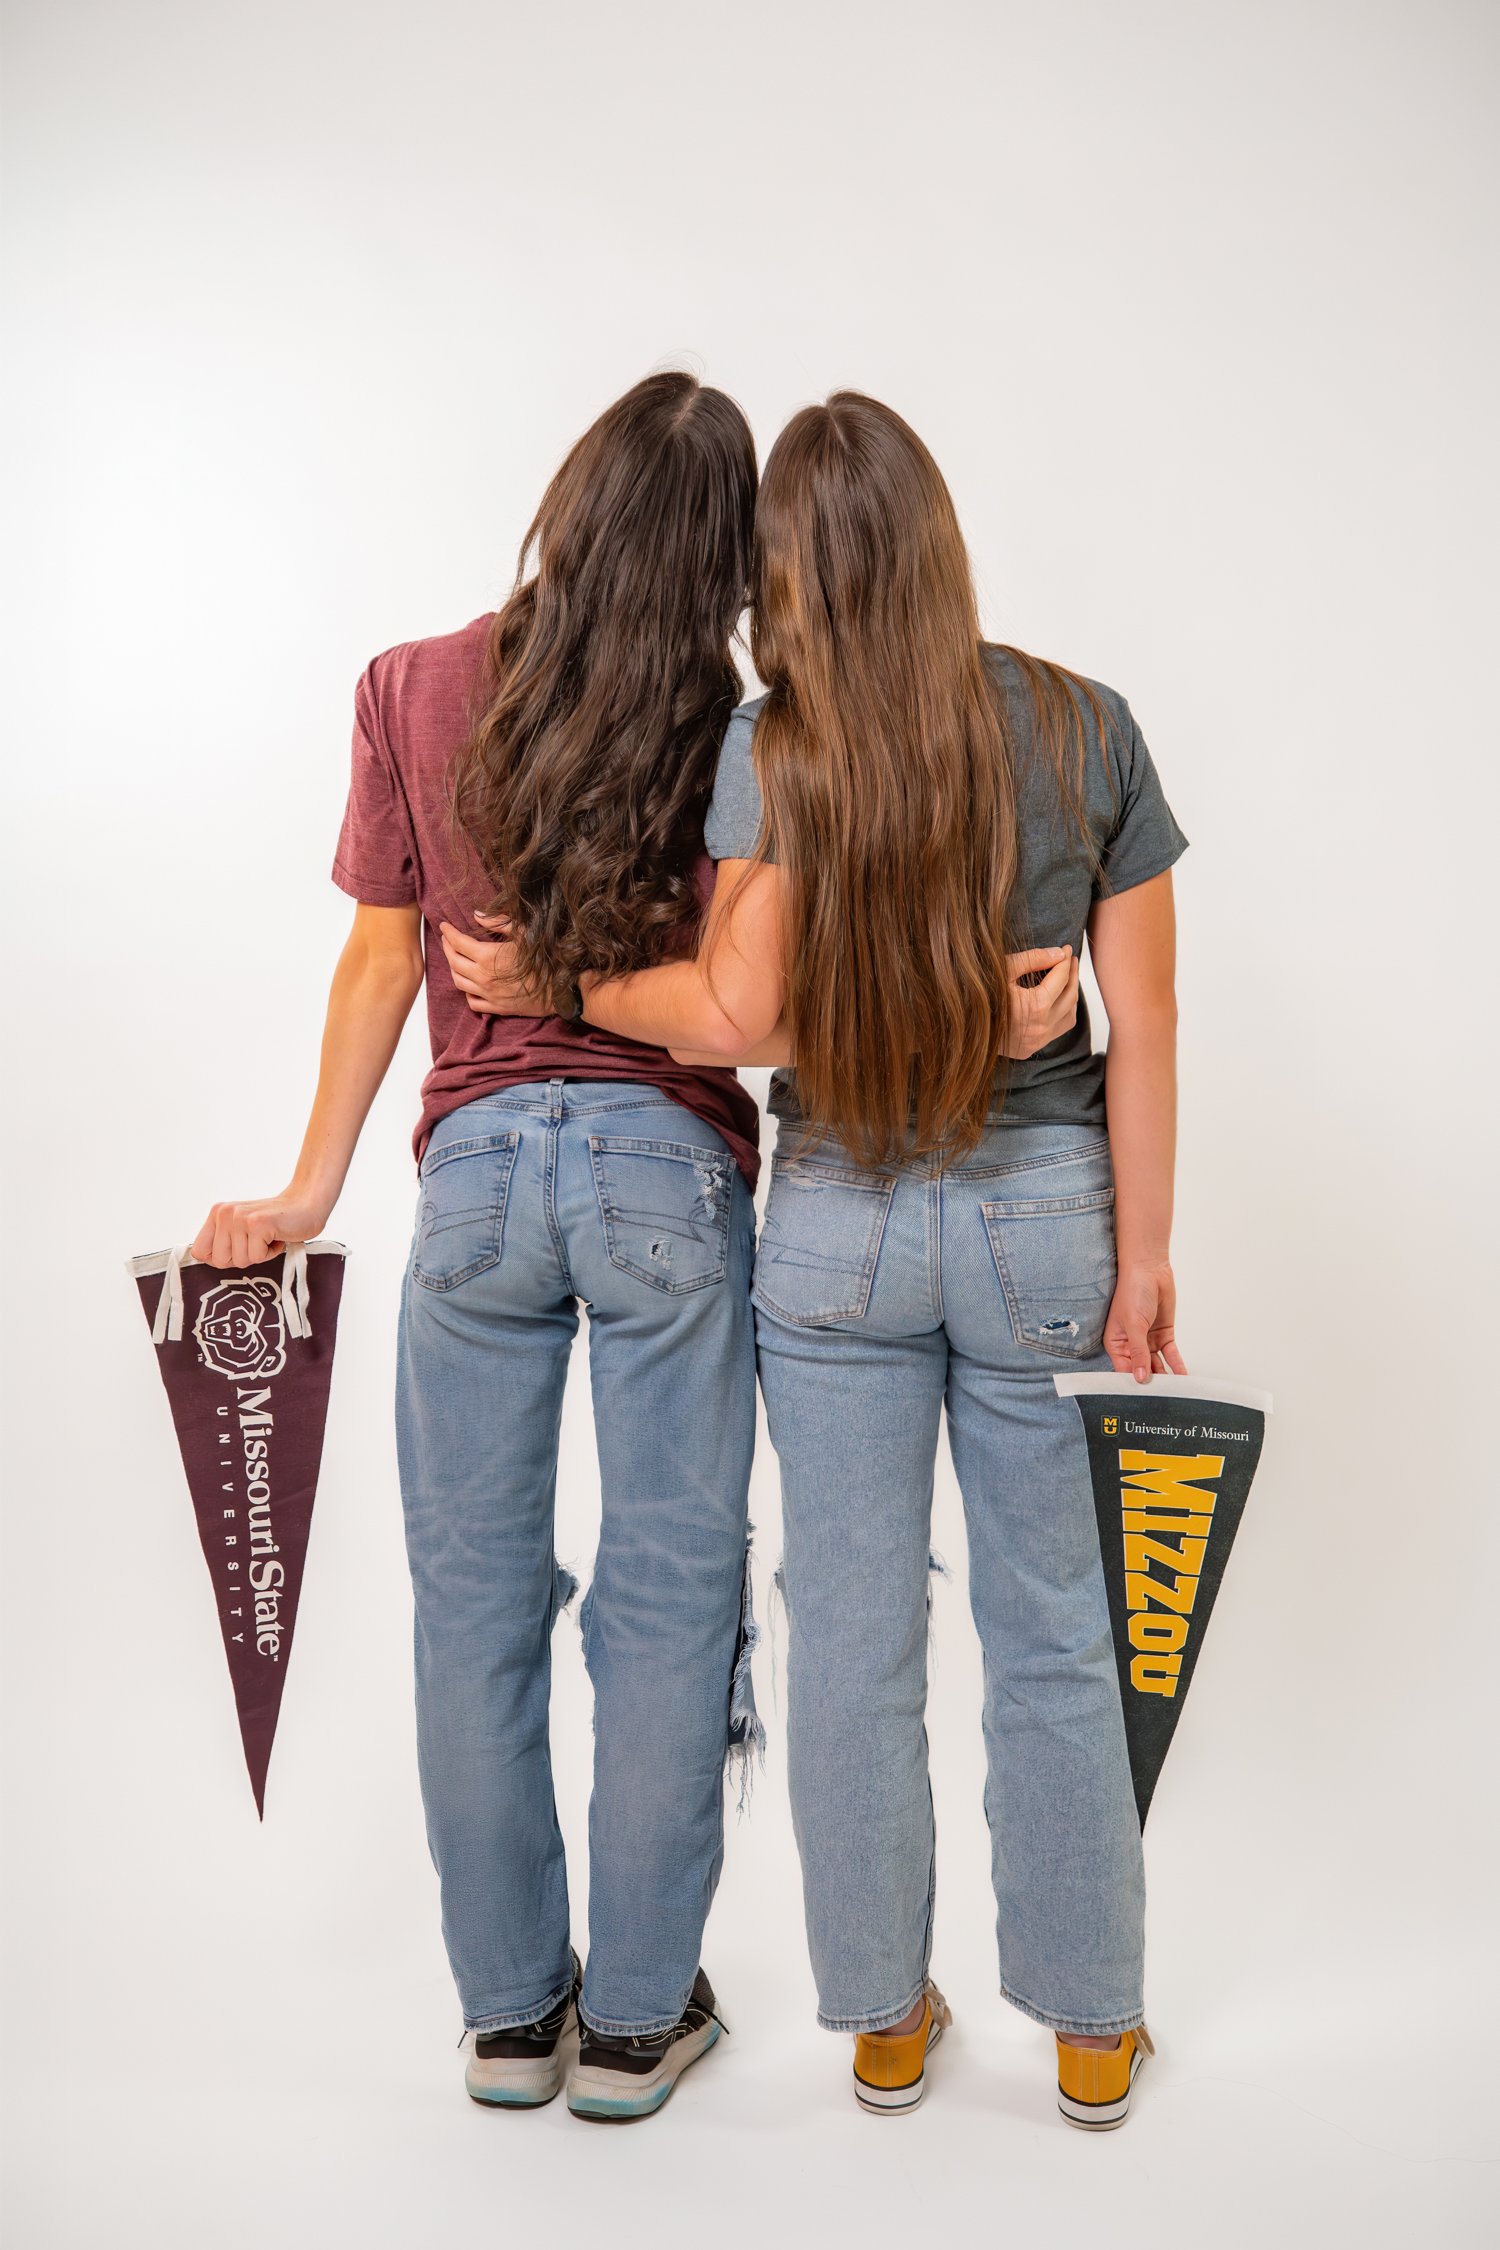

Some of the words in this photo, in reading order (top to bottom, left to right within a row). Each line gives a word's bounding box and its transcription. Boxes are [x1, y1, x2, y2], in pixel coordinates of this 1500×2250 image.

[236, 1385, 280, 1557] Missouri
[1124, 1421, 1182, 1439] University
[1184, 1425, 1198, 1437] of
[1200, 1426, 1249, 1441] Missouri
[216, 1406, 244, 1643] UNIVERSITY
[248, 1560, 285, 1656] State
[1118, 1449, 1225, 1697] MIZZOU
